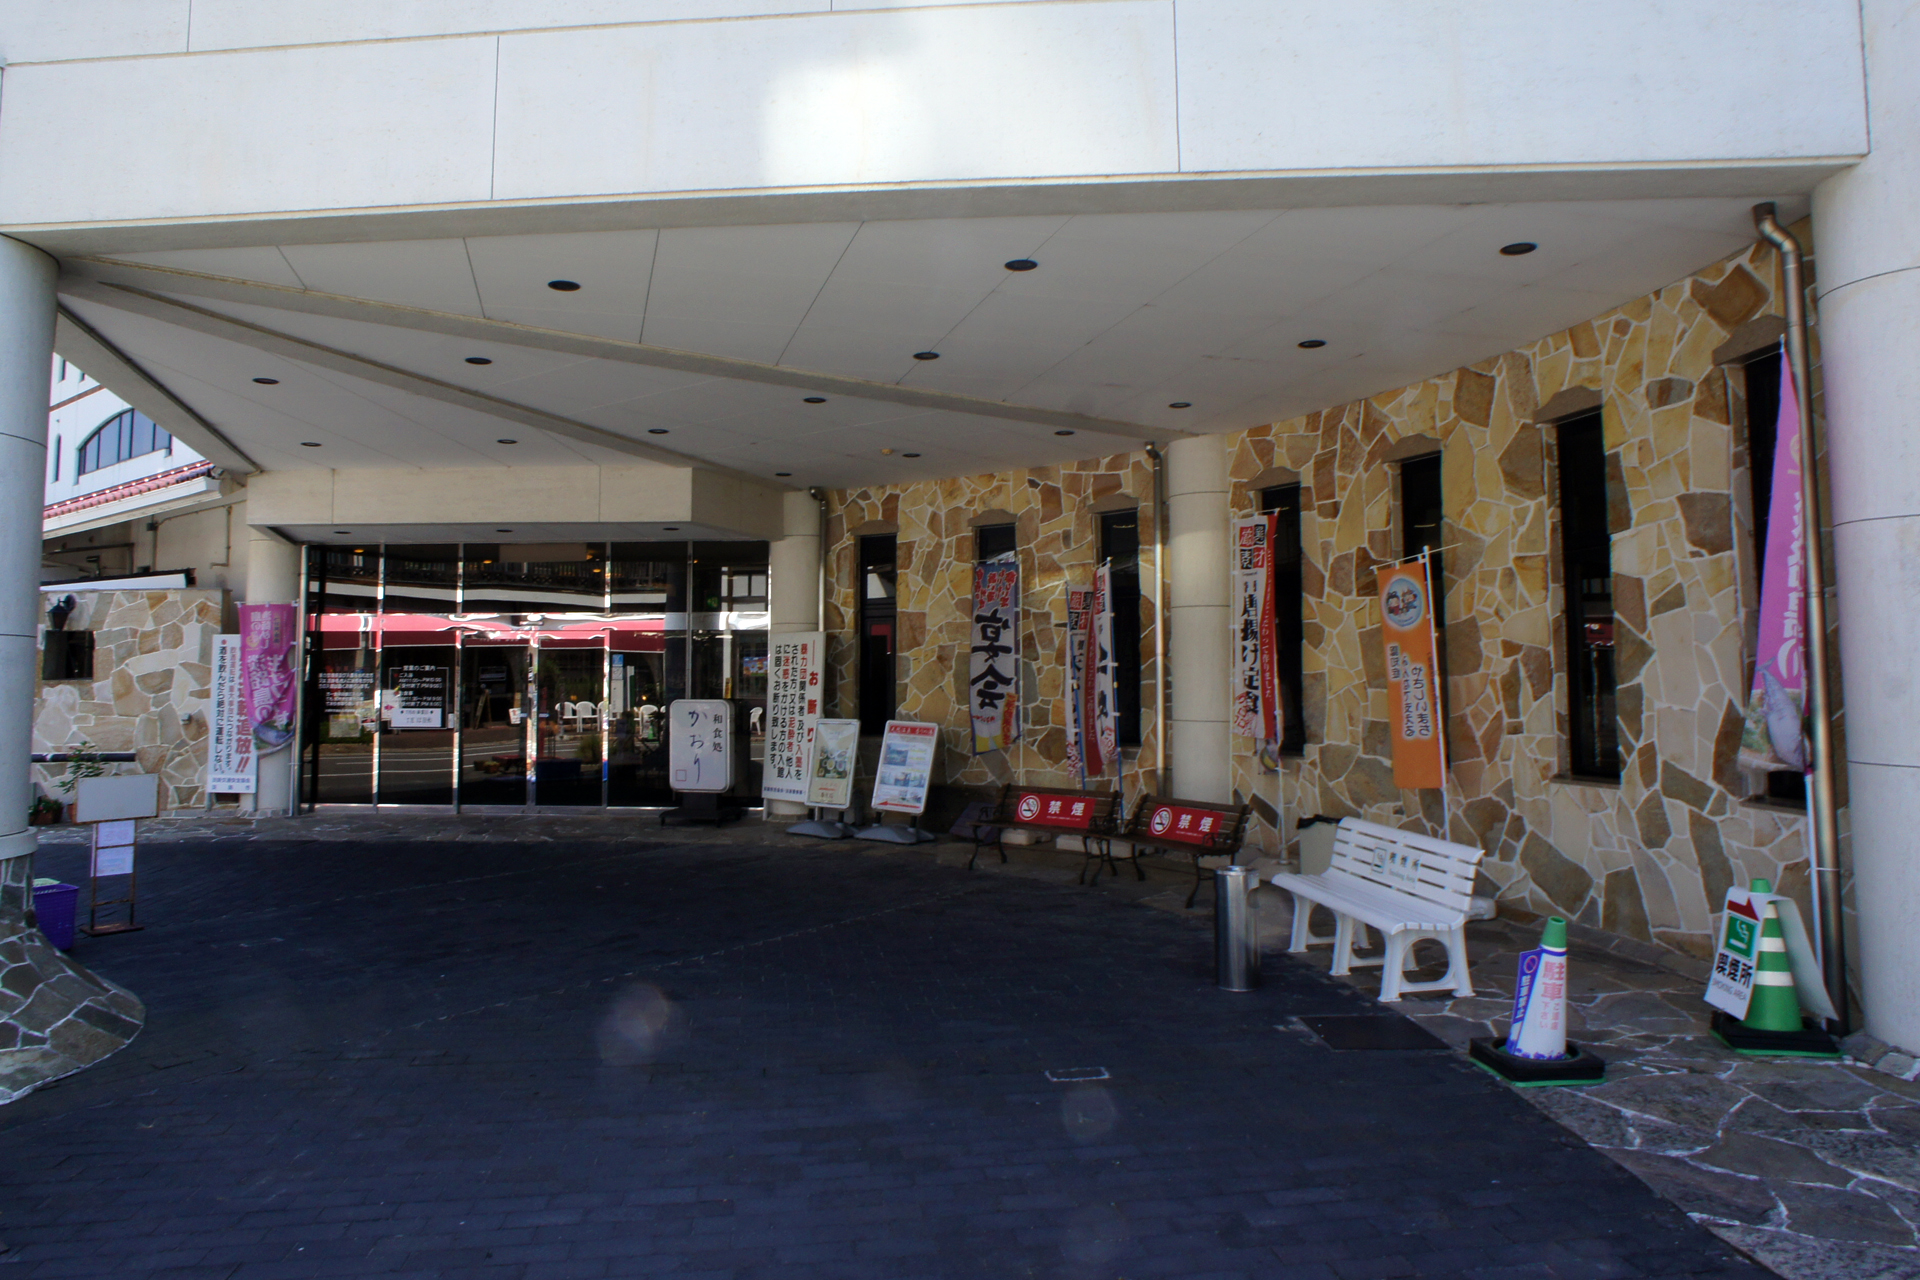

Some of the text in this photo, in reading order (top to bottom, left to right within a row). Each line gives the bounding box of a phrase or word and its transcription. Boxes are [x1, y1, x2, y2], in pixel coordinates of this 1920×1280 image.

[970, 608, 1015, 710] 宴会
[712, 713, 723, 753] 和食処
[768, 644, 782, 769] は固くお断り致します。
[775, 644, 790, 778] に迷惑をかける方の入館
[806, 671, 819, 743] お断り
[688, 709, 708, 784] かおり
[1047, 800, 1086, 816] 禁煙
[1177, 813, 1214, 832] 禁煙
[1541, 961, 1565, 1001] 駐車
[1715, 952, 1755, 989] 喫煙所
